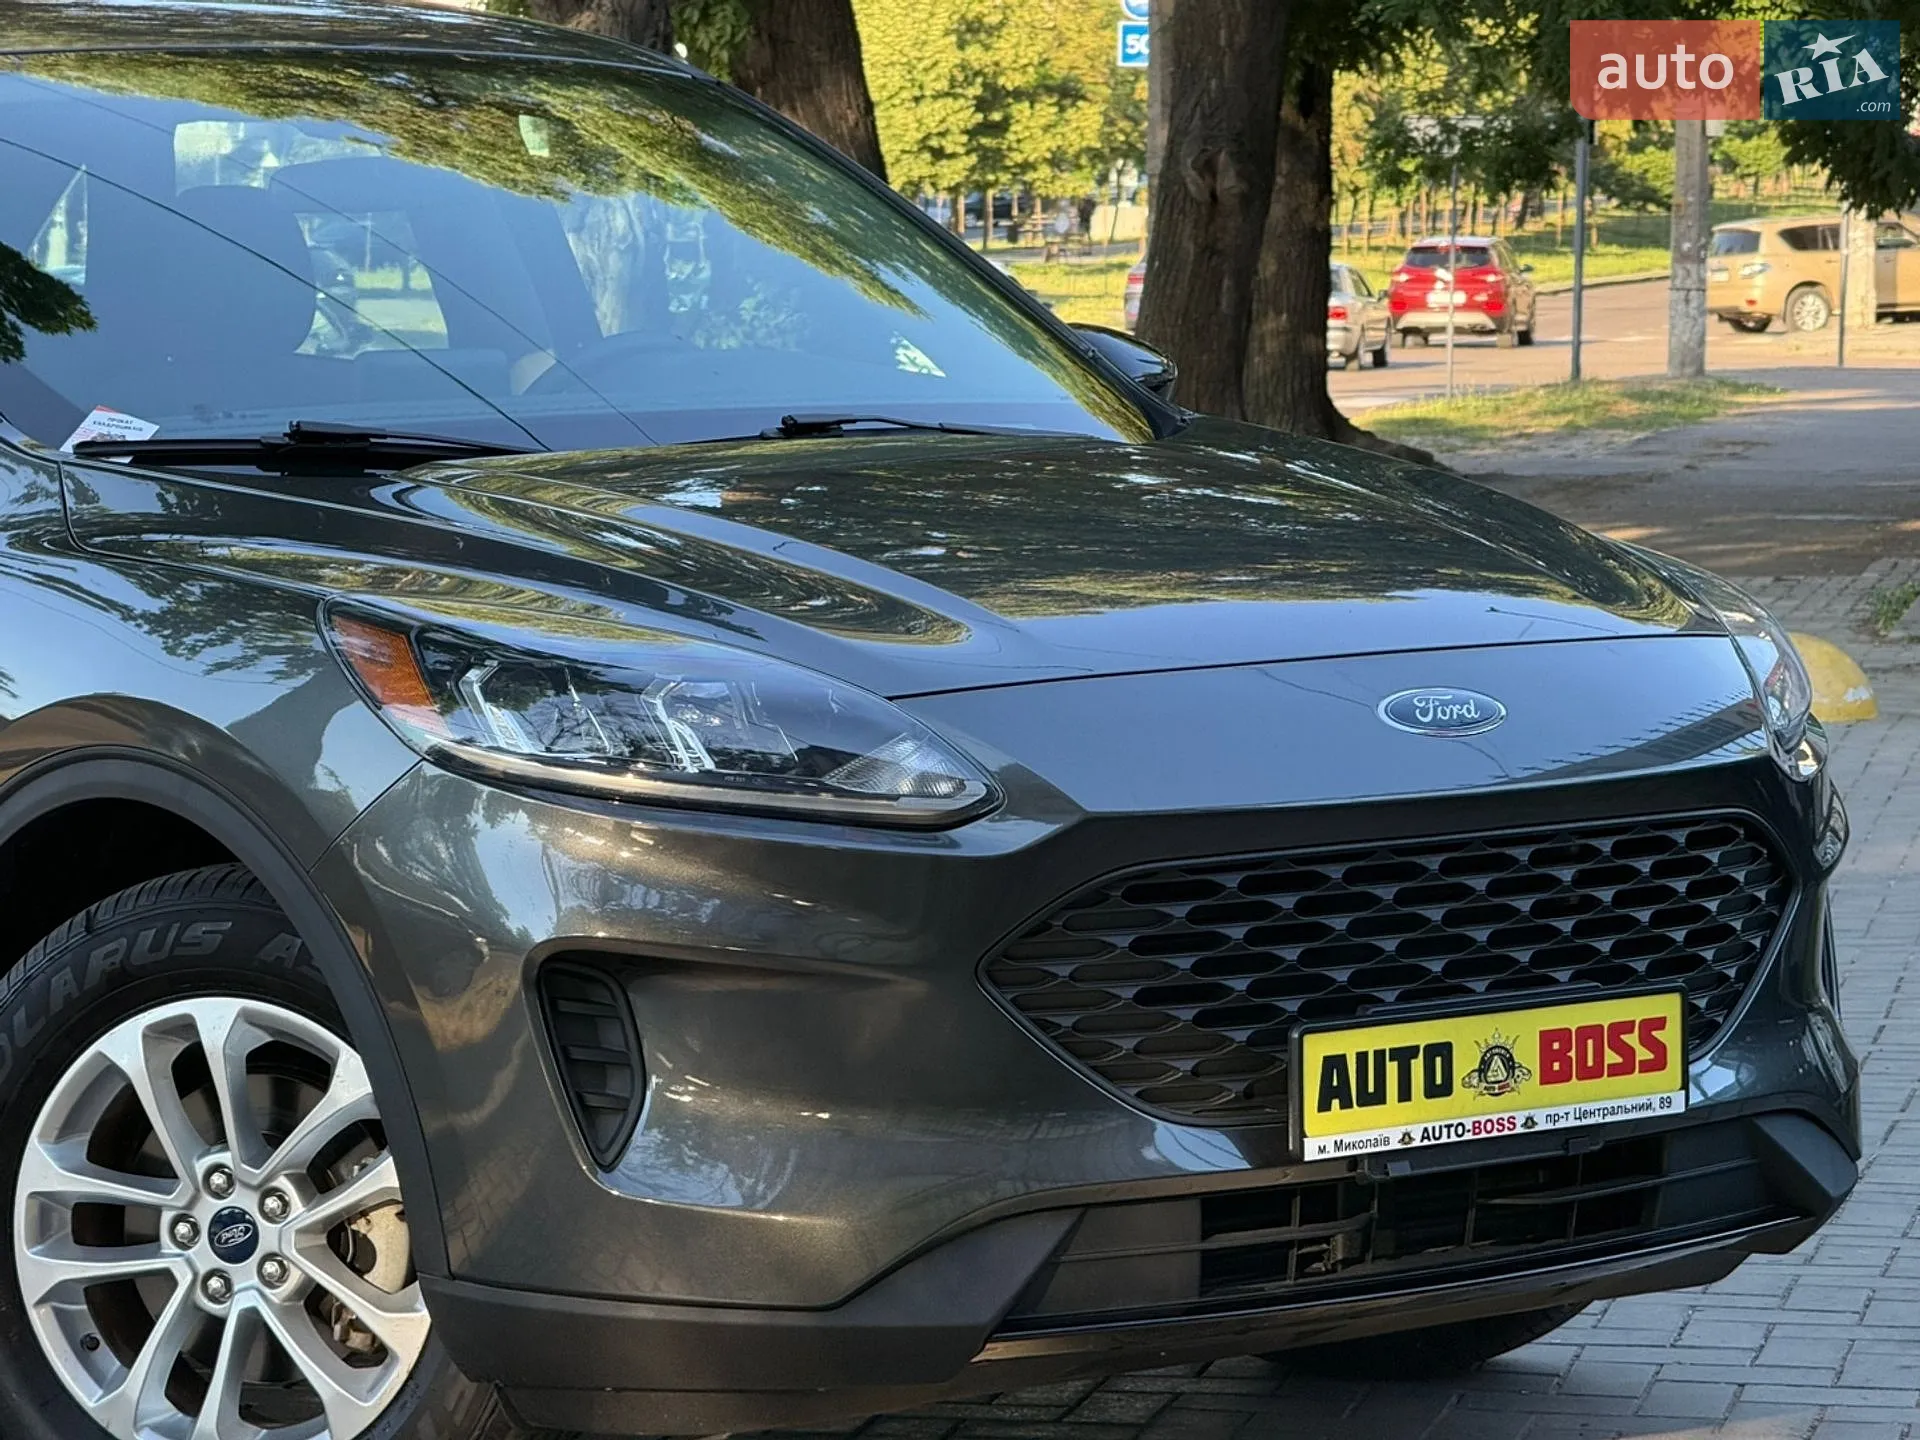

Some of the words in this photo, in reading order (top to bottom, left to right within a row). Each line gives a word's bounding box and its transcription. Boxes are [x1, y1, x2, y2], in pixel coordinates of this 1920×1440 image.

[1413, 695, 1480, 722] Ford
[1317, 1041, 1454, 1113] AUTO
[1539, 1016, 1668, 1086] BOSS
[1317, 1144, 1330, 1155] м.
[1333, 1134, 1391, 1153] Миколаїв
[1420, 1115, 1517, 1143] AUTO-BOSS
[1545, 1111, 1571, 1127] пр-т
[1573, 1098, 1656, 1121] Центральний,
[1658, 1096, 1673, 1110] 89
